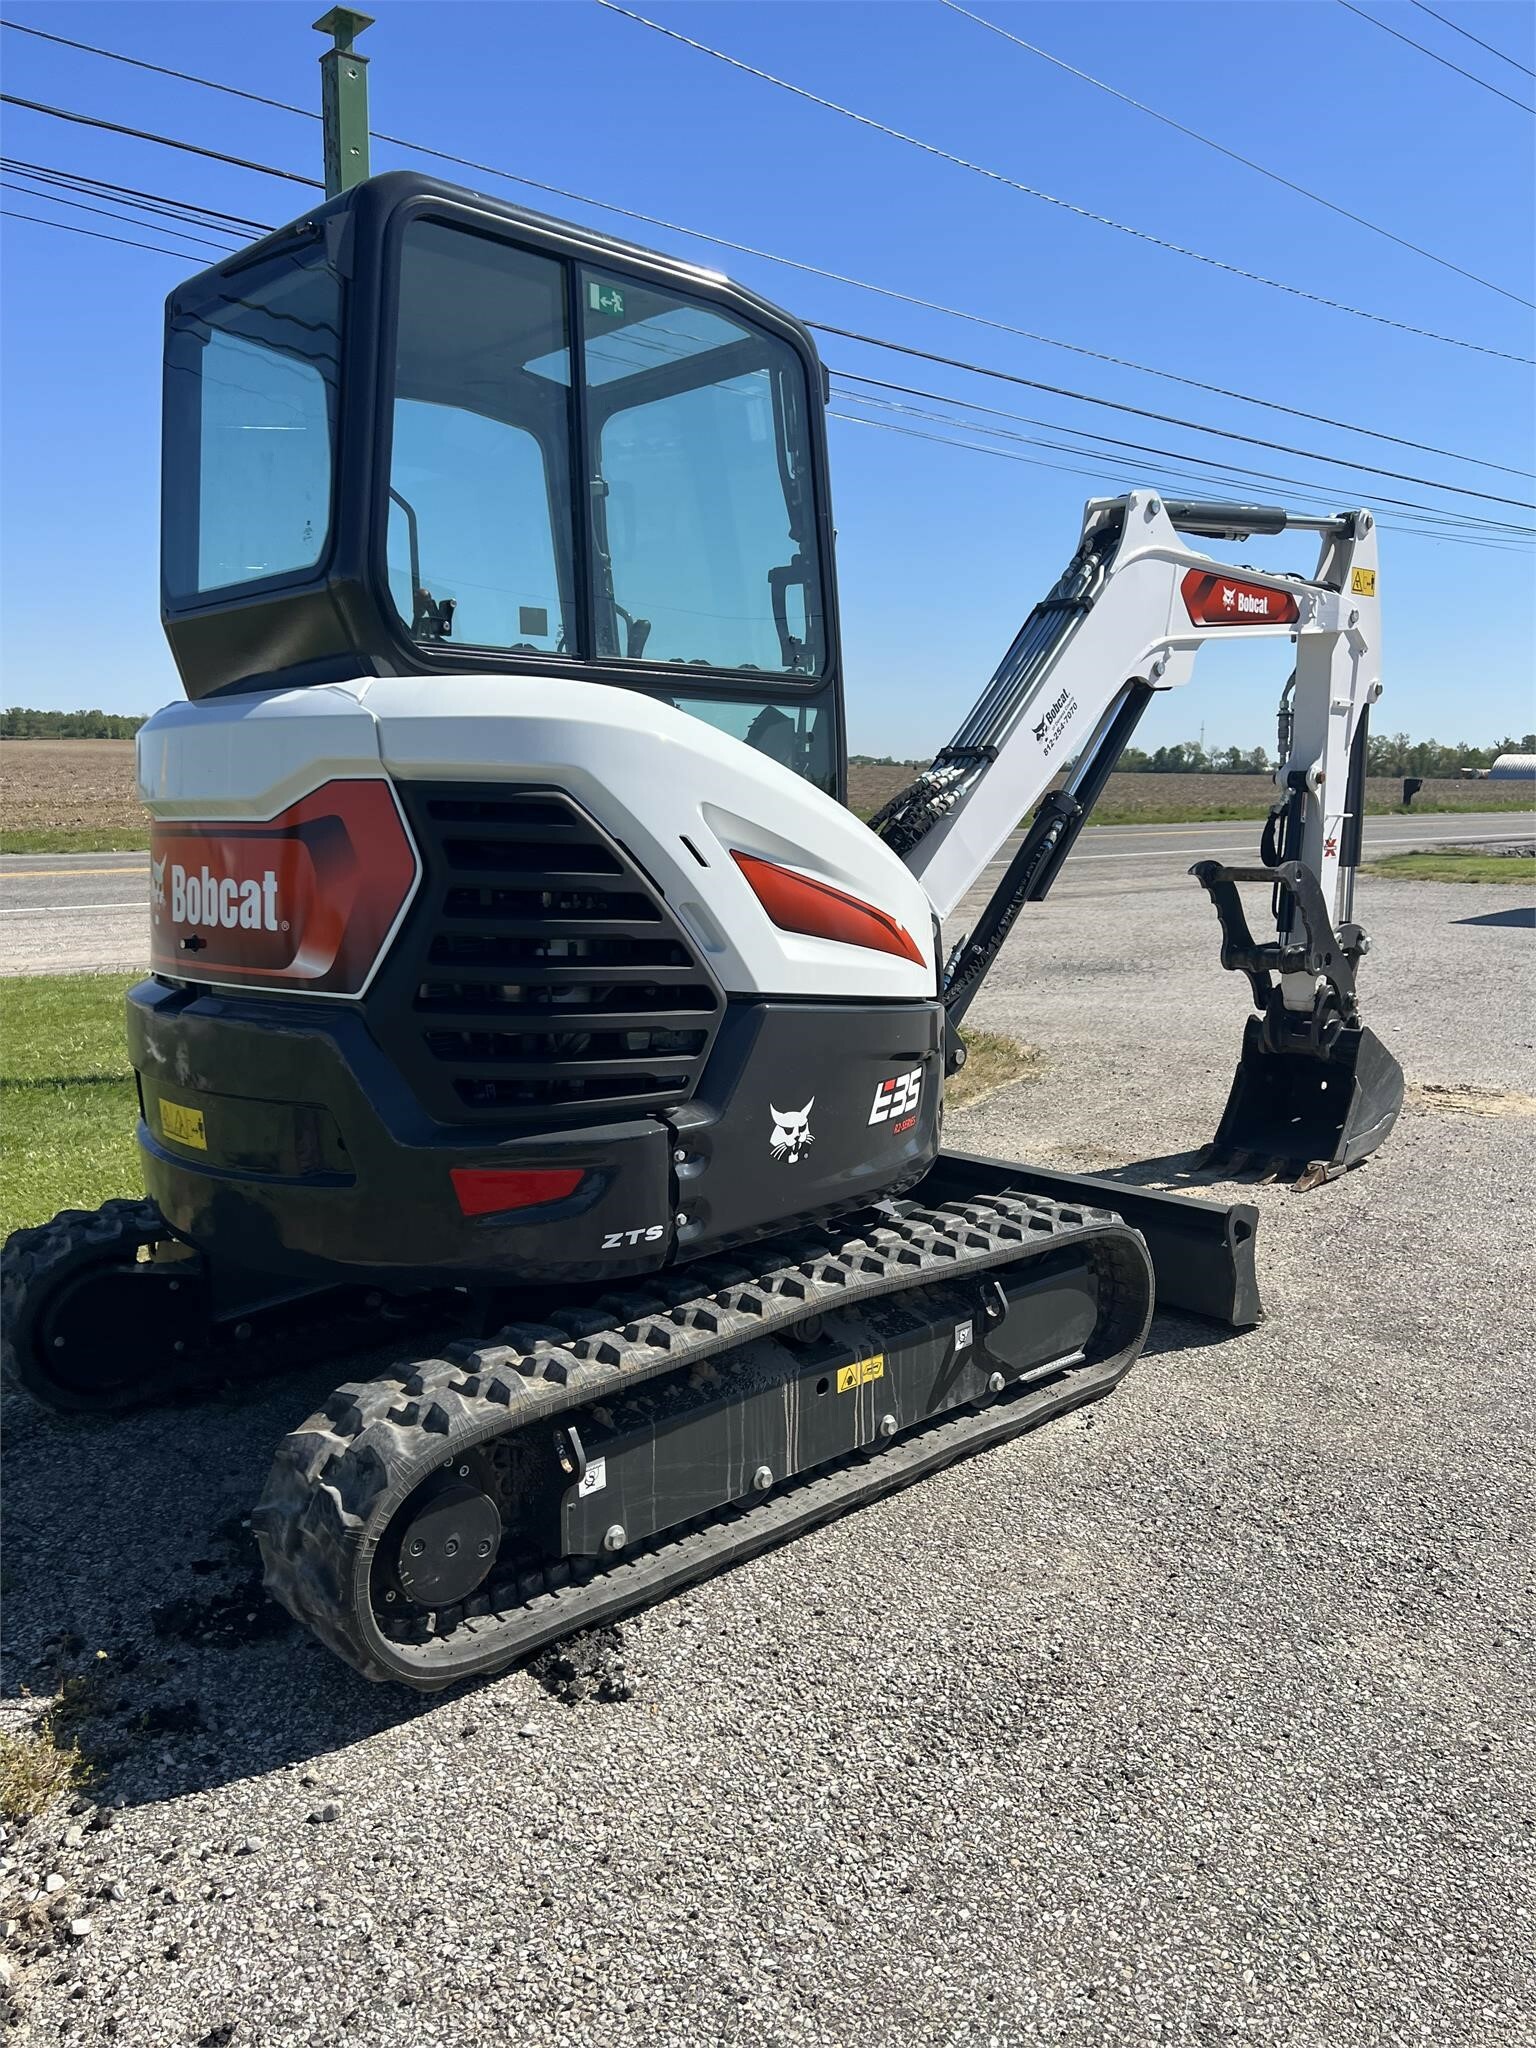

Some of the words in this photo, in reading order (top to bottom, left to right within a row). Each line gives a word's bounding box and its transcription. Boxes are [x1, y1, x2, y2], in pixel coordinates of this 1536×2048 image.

[1237, 592, 1268, 615] Bobcat
[1043, 702, 1078, 756] 812-254-7070
[1045, 688, 1069, 725] Bobcat
[171, 864, 278, 931] Bobcat
[868, 1067, 922, 1126] E35
[601, 1225, 664, 1249] ZTS
